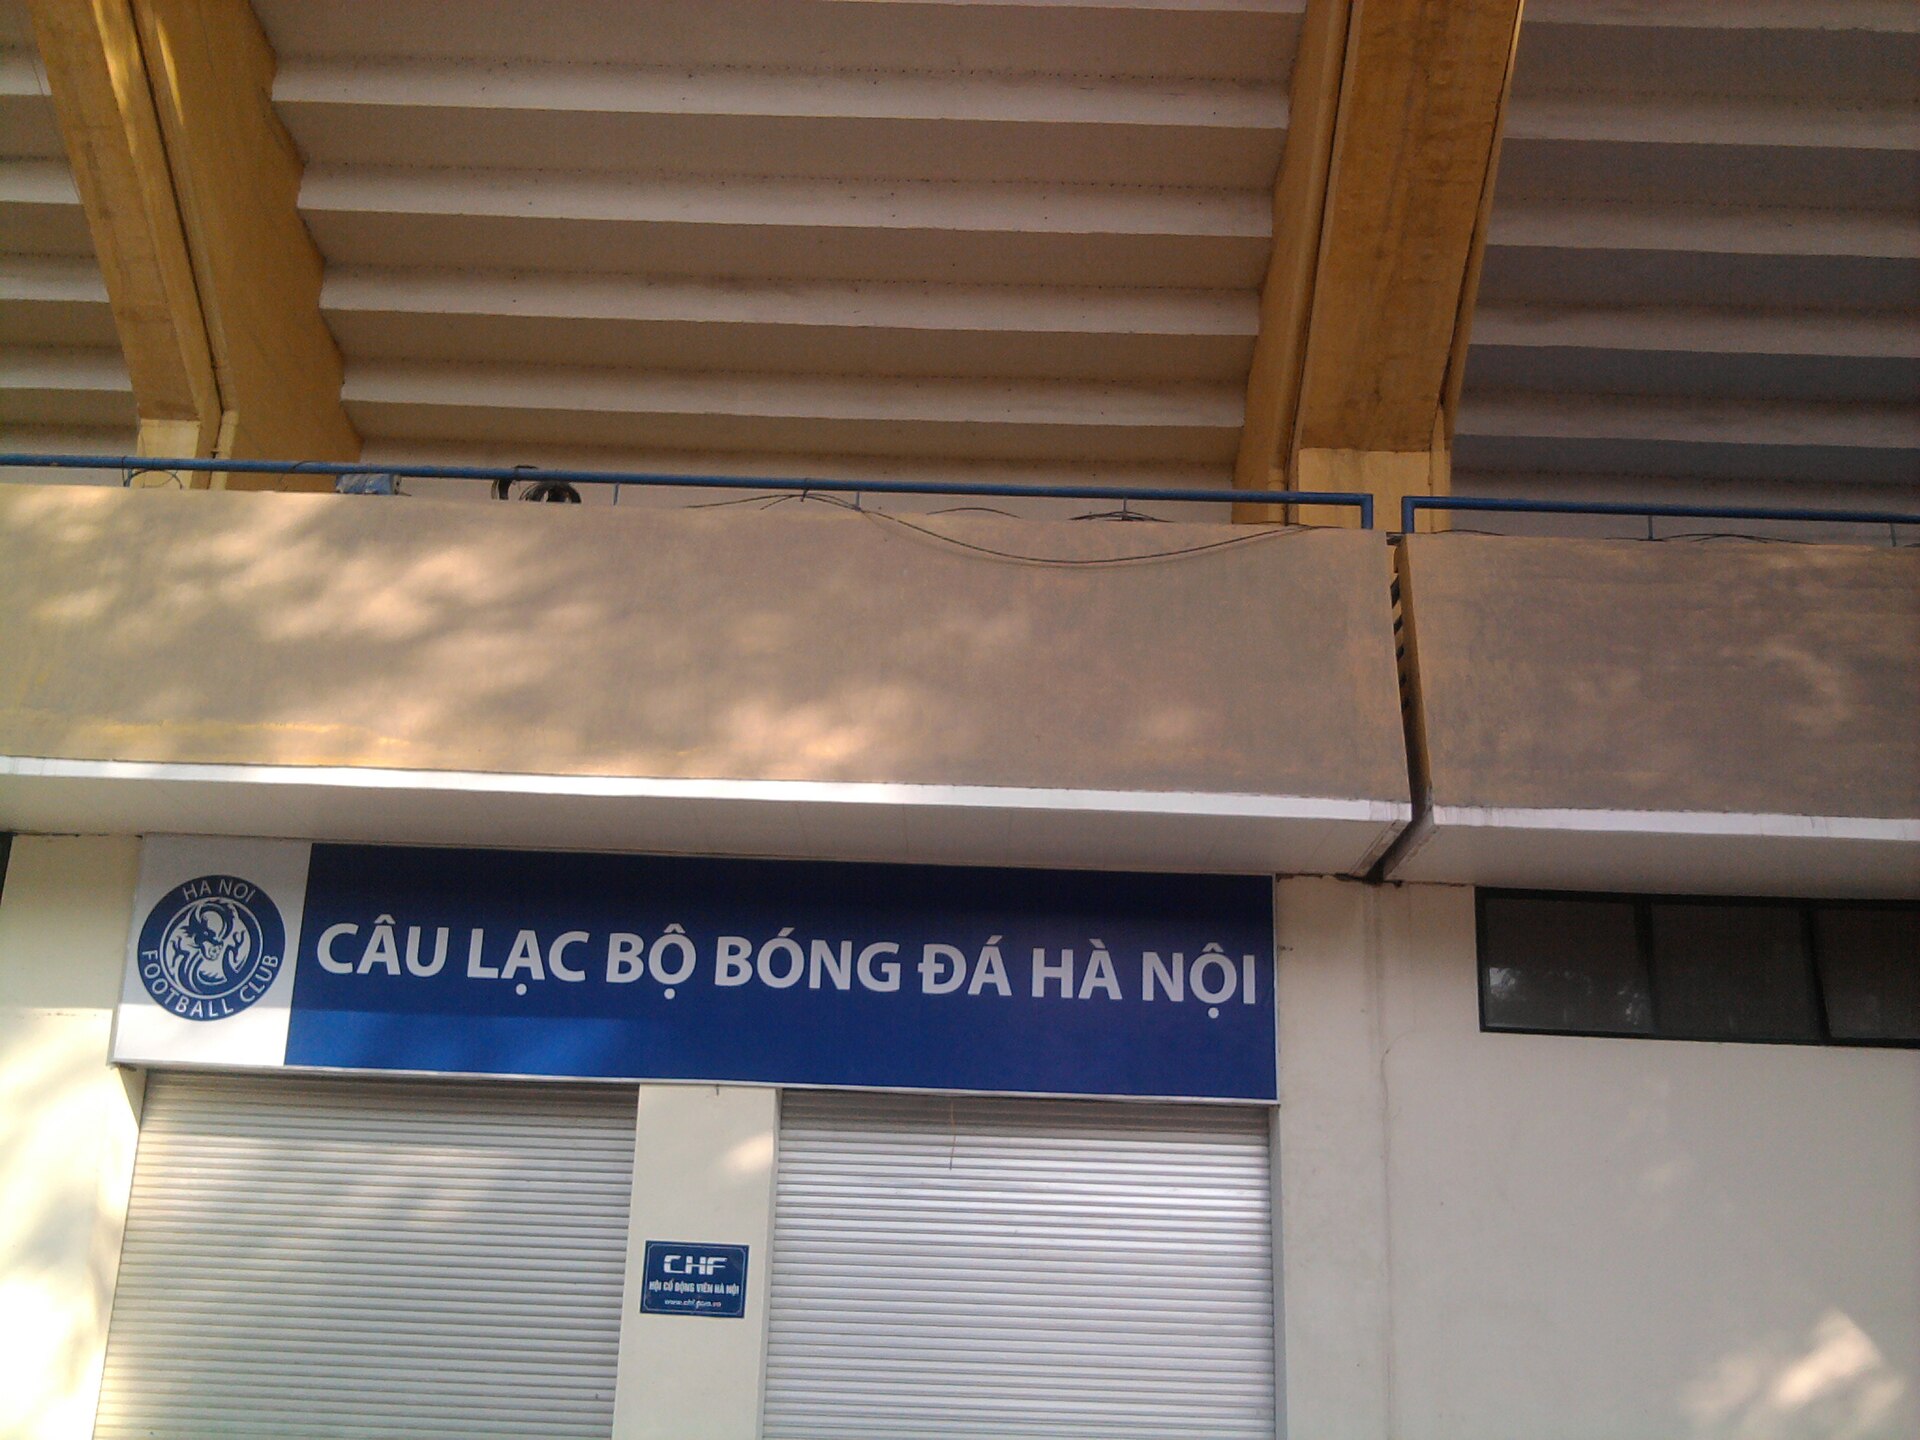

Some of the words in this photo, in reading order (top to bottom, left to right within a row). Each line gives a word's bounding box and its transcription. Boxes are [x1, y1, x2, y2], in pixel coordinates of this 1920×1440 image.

[182, 882, 212, 901] HA
[142, 949, 234, 1017] FOOTBALL
[239, 954, 279, 1003] CLUB
[316, 913, 450, 977] CÂU
[466, 928, 590, 996] LẠC
[606, 923, 697, 1000] BỘ
[714, 926, 902, 994] BÓNG
[917, 935, 1012, 997] ĐÁ
[1031, 938, 1123, 1000] HÀ
[1141, 942, 1257, 1019] NỘI
[663, 1254, 728, 1275] CHF
